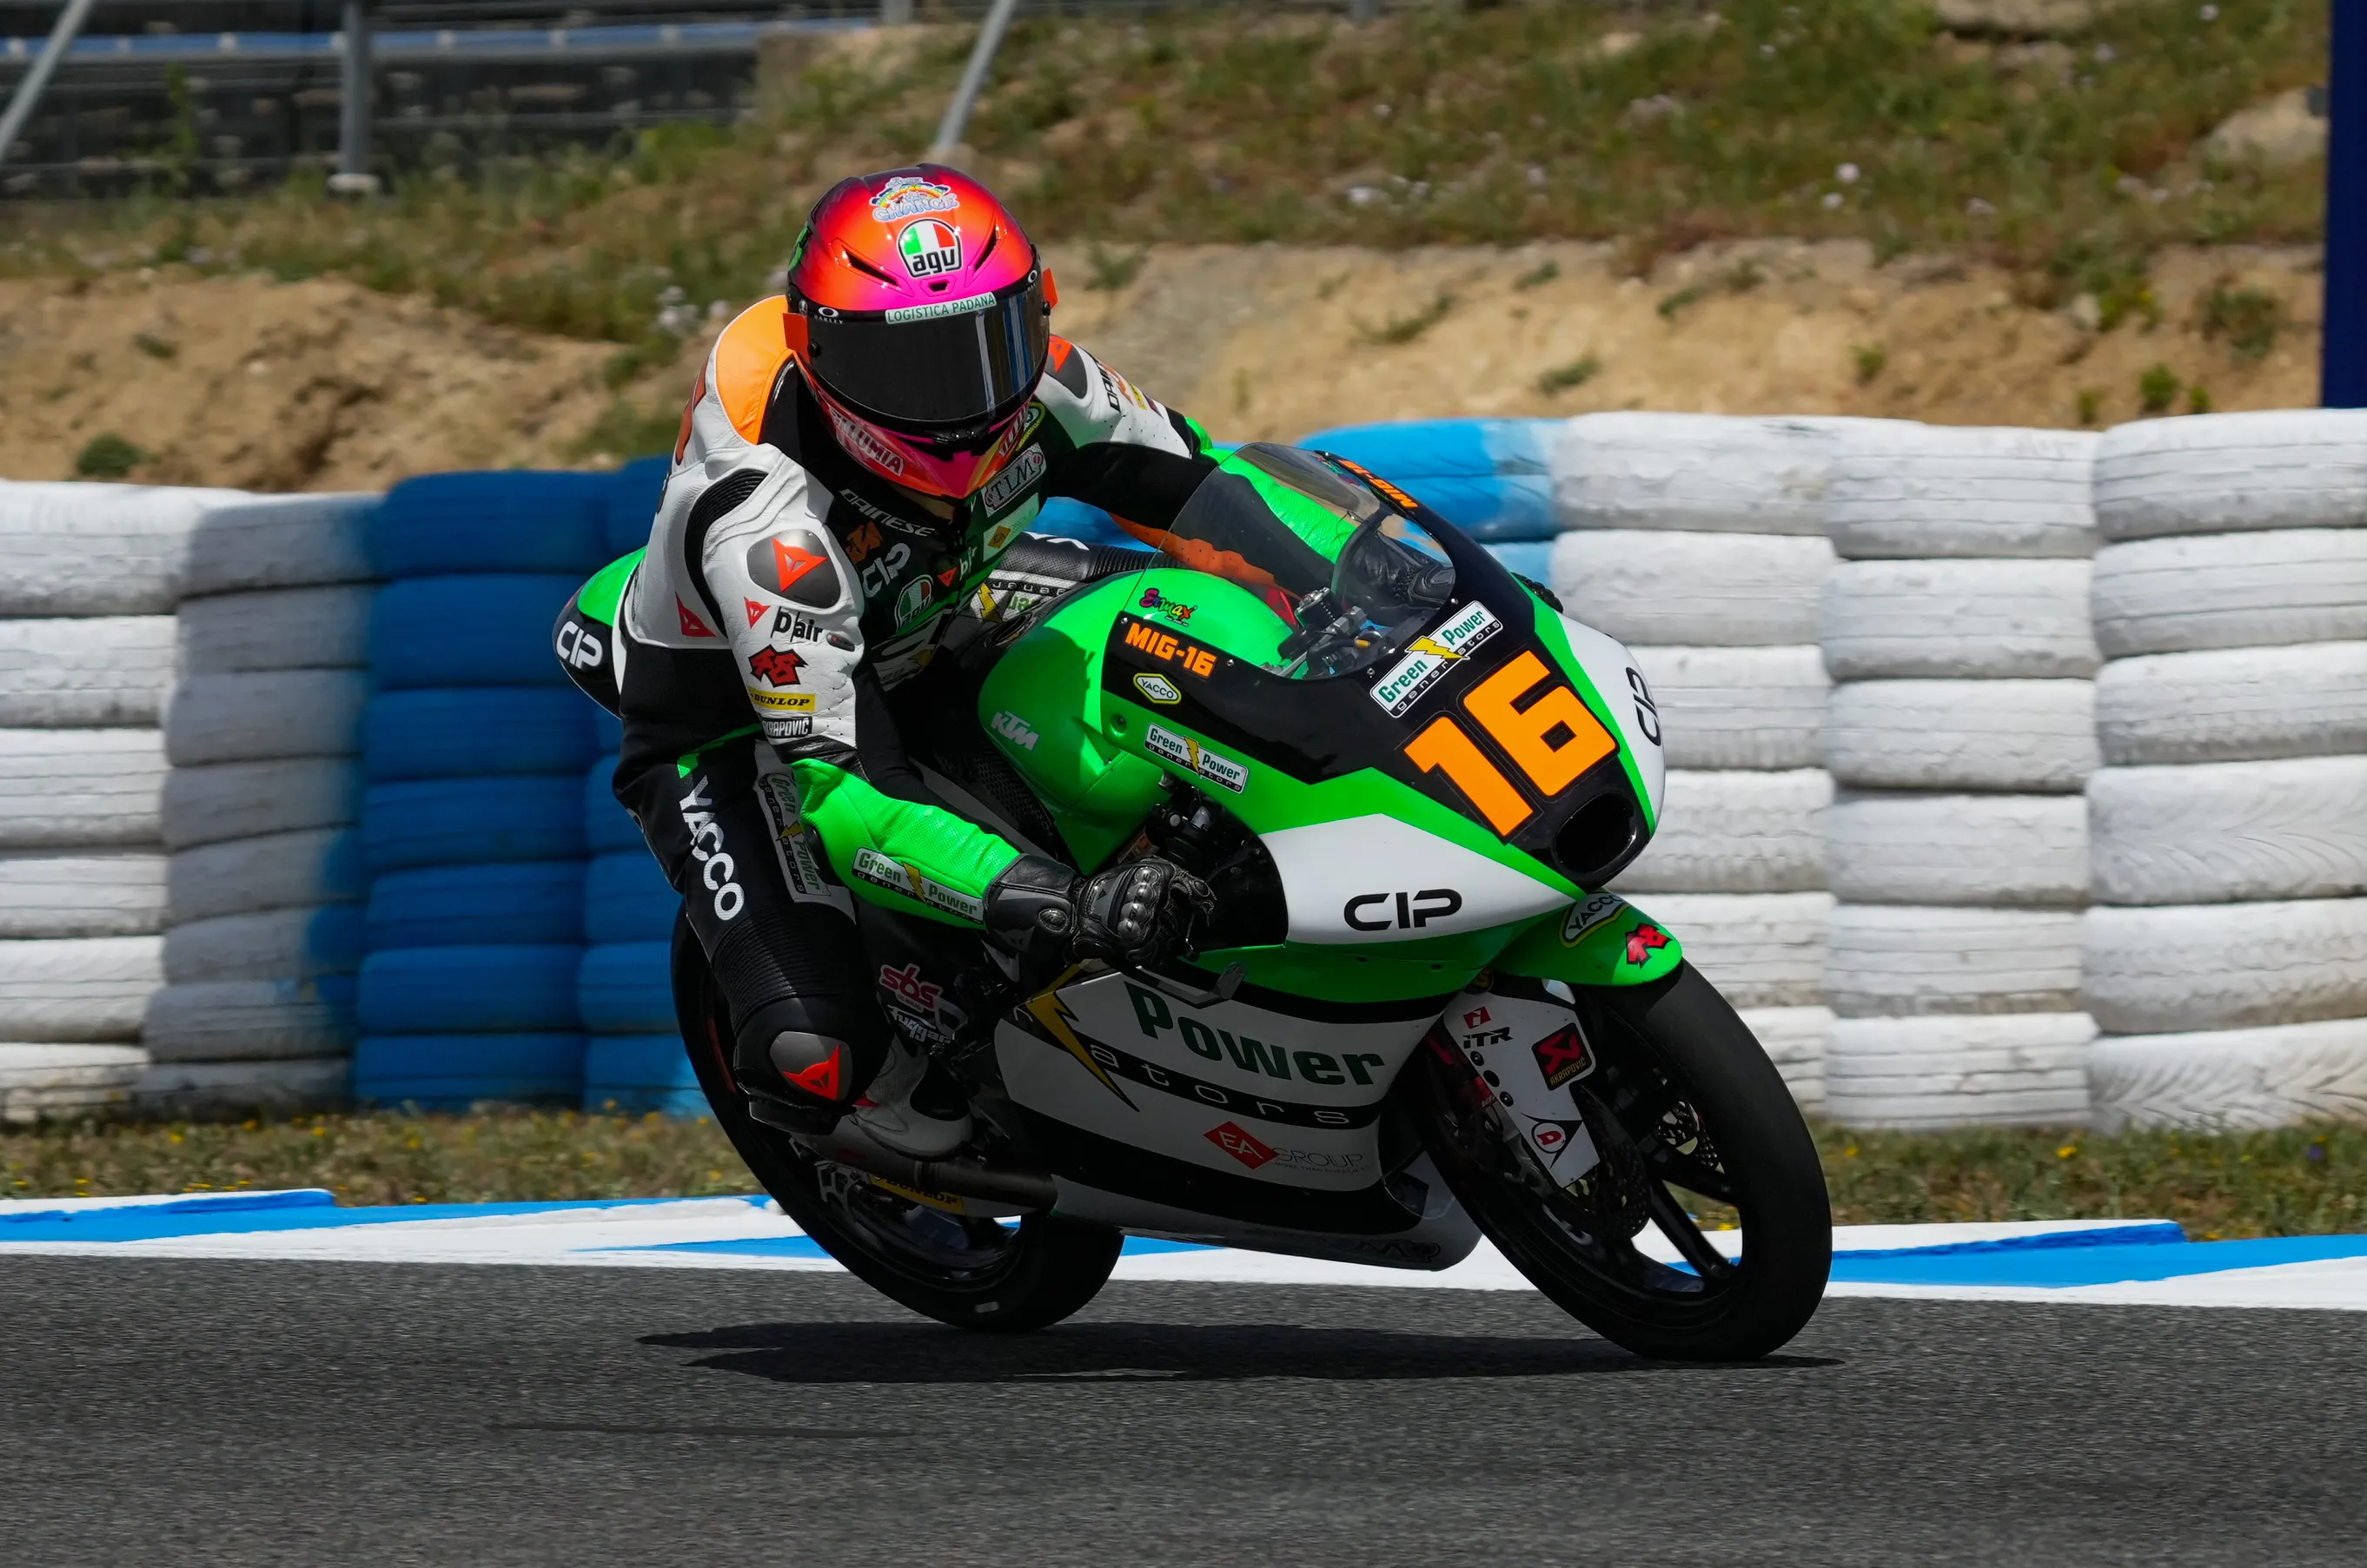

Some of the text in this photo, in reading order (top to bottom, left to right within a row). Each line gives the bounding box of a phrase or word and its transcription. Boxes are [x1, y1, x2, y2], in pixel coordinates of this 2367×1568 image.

[912, 249, 956, 275] agv
[887, 294, 995, 322] LOGISTICA PADANA
[839, 488, 937, 537] DAINESE
[557, 620, 603, 669] CIP
[1124, 622, 1217, 678] MIG-16
[1378, 610, 1486, 704] Green Power
[753, 694, 810, 706] DUNLOP
[1141, 678, 1175, 699] YACCO
[762, 718, 810, 738] KRAPOVIČ
[991, 711, 1040, 751] KTM
[1404, 650, 1618, 837] 16
[1150, 728, 1240, 780] Green Power
[680, 775, 745, 921] YACCO
[858, 851, 978, 915] Green Power
[1344, 889, 1463, 931] CIP
[881, 967, 941, 1009] sbs
[1124, 981, 1385, 1086] Power
[1272, 1148, 1363, 1168] GROUP
